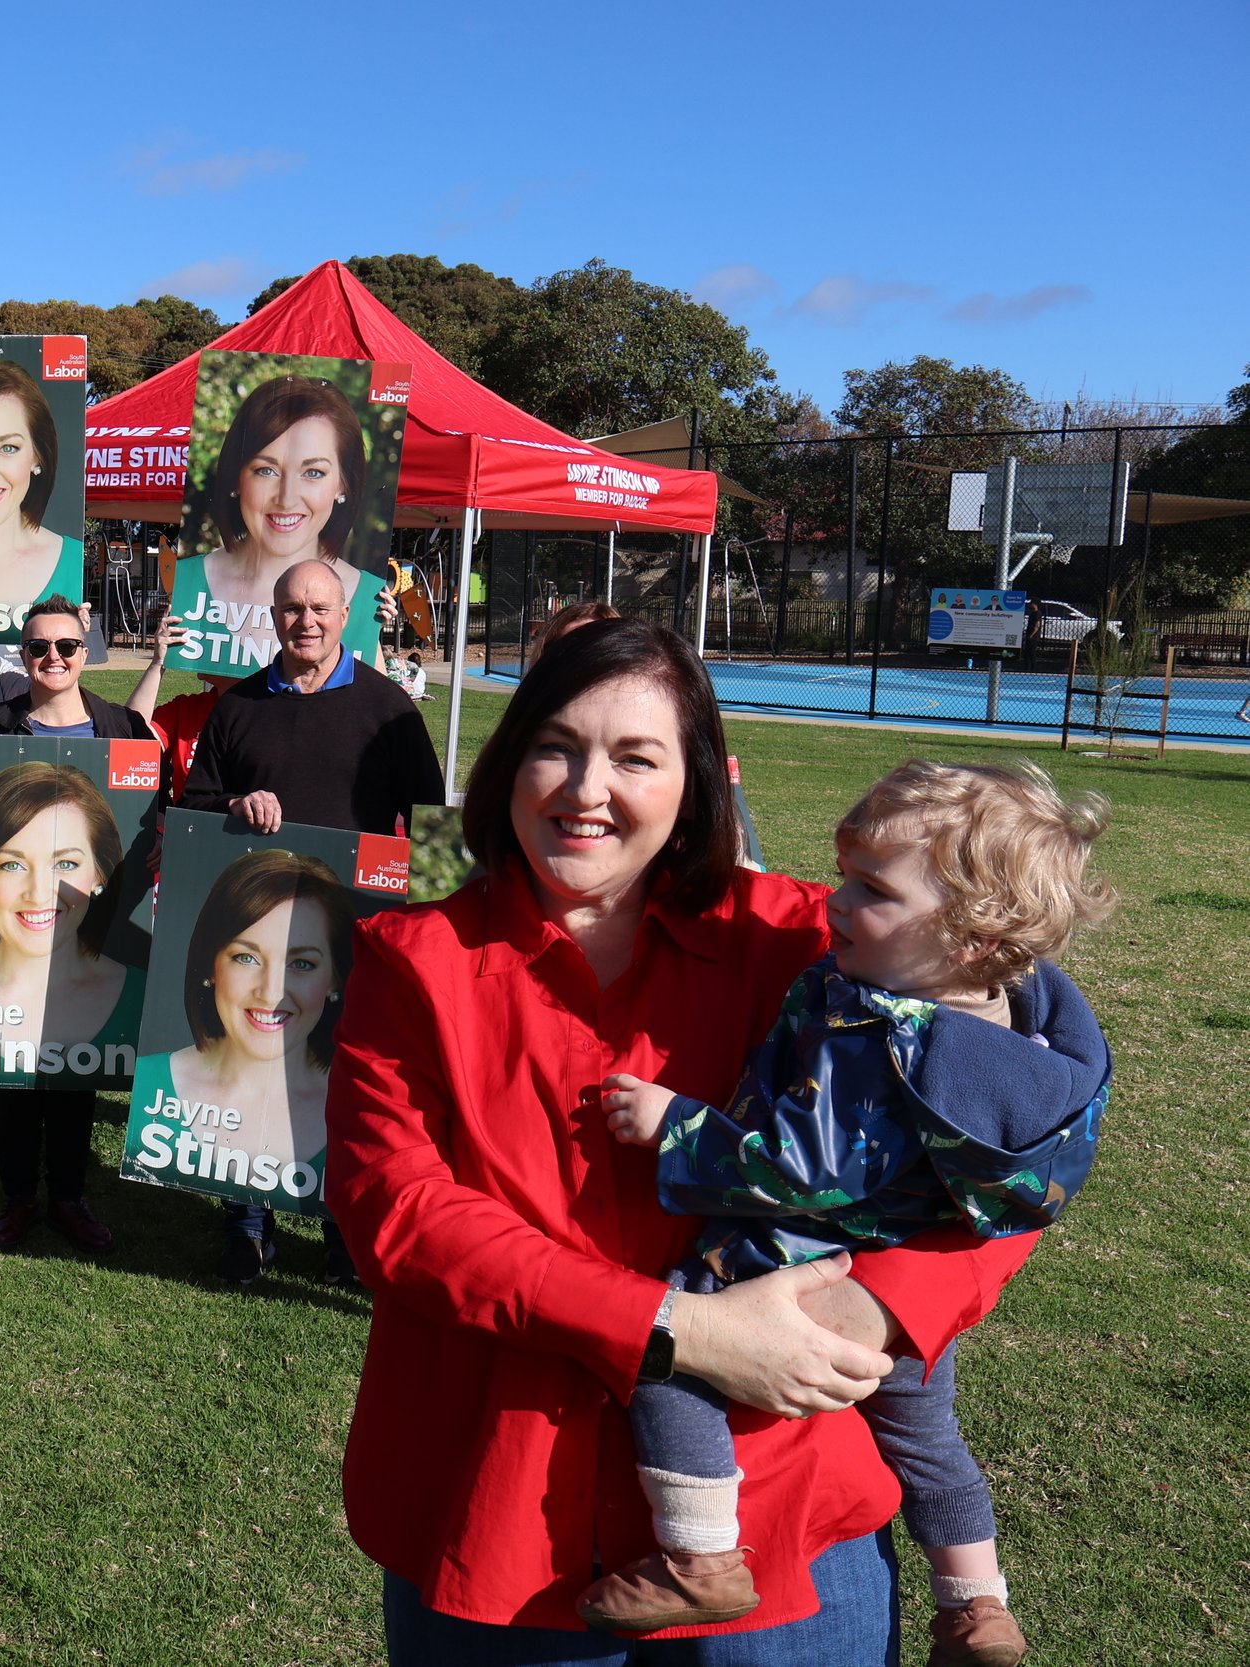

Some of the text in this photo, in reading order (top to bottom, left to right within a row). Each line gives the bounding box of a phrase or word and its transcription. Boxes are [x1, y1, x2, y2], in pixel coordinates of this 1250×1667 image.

[45, 365, 85, 377] Labor
[371, 390, 409, 403] Labor
[85, 427, 163, 437] AYNE
[85, 446, 190, 468] YNE STINS
[86, 472, 140, 487] EMBER
[145, 472, 176, 486] FOR
[567, 463, 660, 494] JAYNE STINSON MP
[575, 488, 608, 504] MEMBER
[608, 491, 624, 506] FOR
[183, 592, 275, 632] Jayn
[178, 629, 284, 669] STIN
[112, 772, 157, 786] Labor
[377, 865, 408, 874] Australian
[390, 860, 409, 869] South
[358, 869, 408, 890] Labor
[144, 1089, 241, 1130] Jayne
[136, 1123, 325, 1201] Stinso
